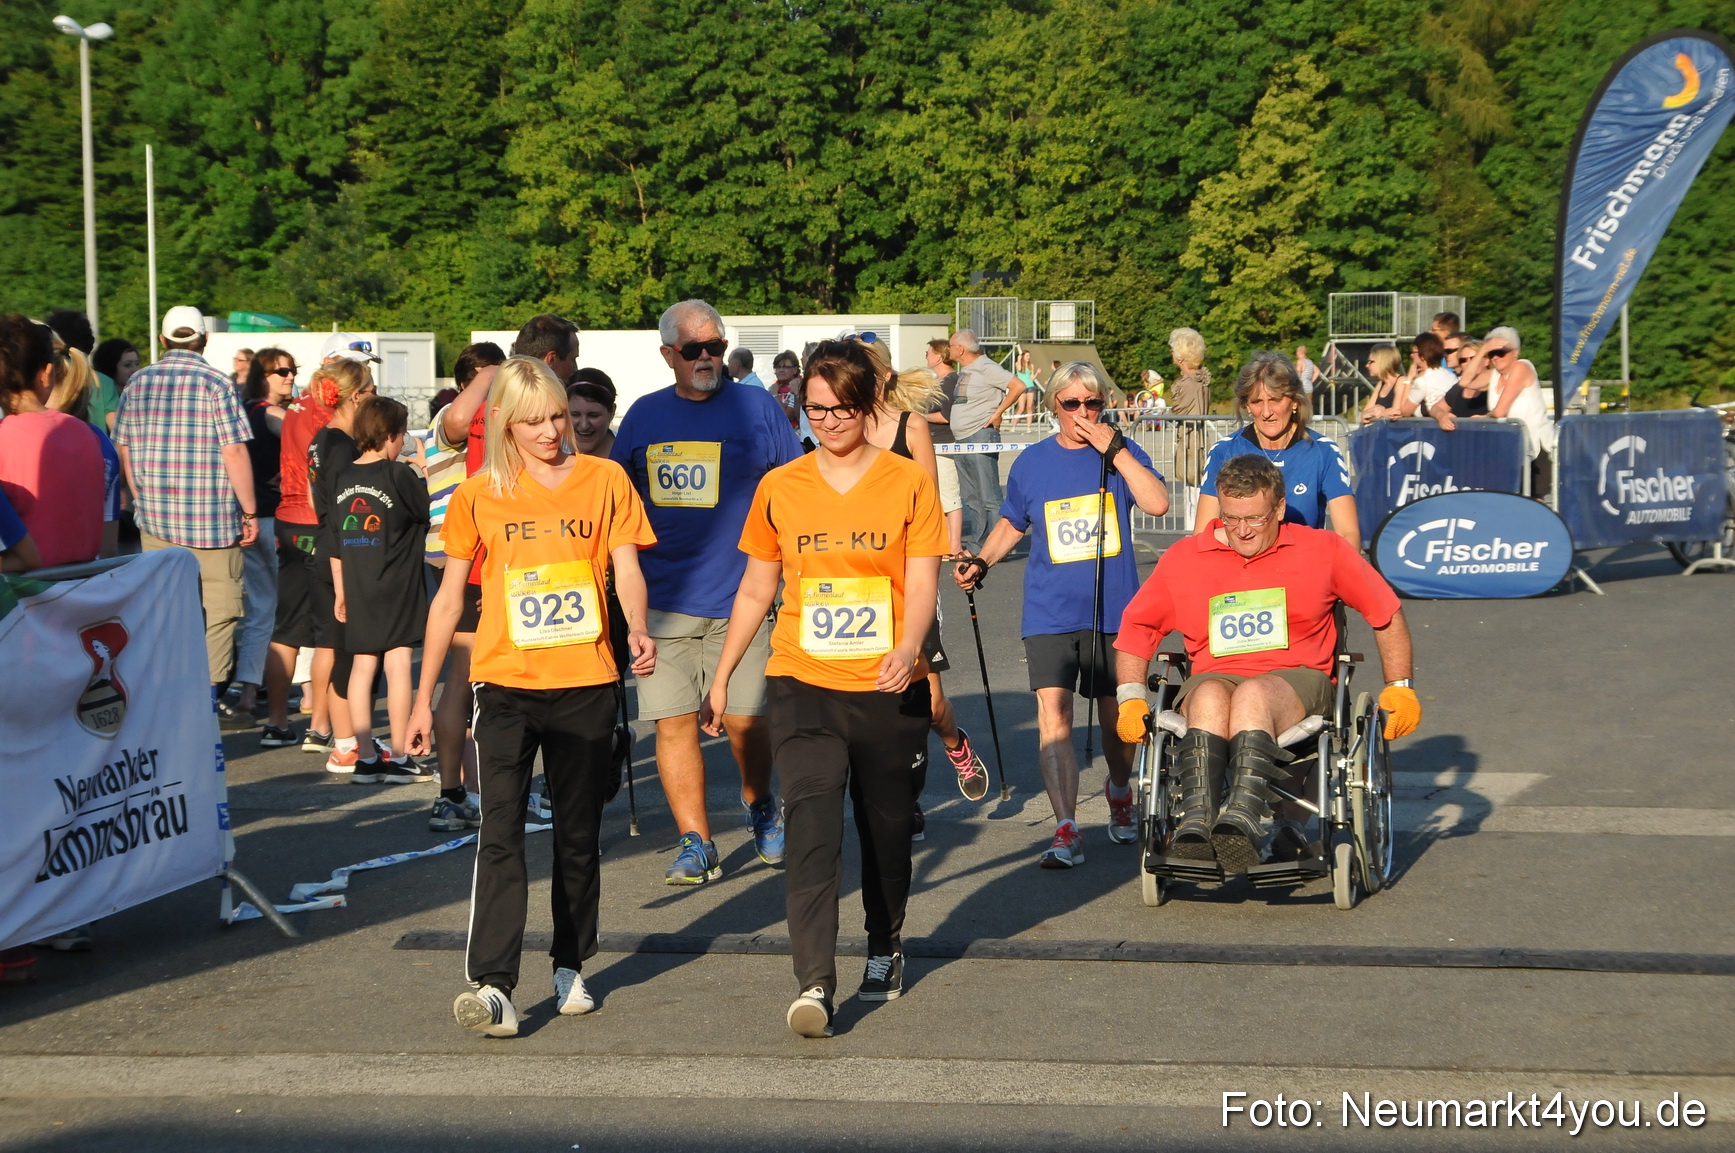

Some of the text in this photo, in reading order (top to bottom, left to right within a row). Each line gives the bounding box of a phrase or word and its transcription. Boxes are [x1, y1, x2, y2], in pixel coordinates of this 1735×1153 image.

[1653, 140, 1686, 180] Druck
[1570, 114, 1692, 270] Frischmann
[1570, 248, 1638, 364] www.frischmann-net.de
[658, 464, 706, 490] 660
[1616, 467, 1695, 504] Fischer
[1625, 507, 1693, 524] AUTOMOBILE
[504, 521, 536, 542] PE
[560, 519, 592, 538] KU
[798, 533, 828, 554] PE
[852, 532, 886, 550] KU
[1058, 518, 1108, 546] 684
[1425, 537, 1549, 562] Fischer
[1437, 562, 1540, 575] AUTOMOBILE
[520, 591, 585, 628] 923
[812, 607, 877, 639] 922
[1220, 611, 1274, 639] 668
[90, 706, 120, 728] 1628
